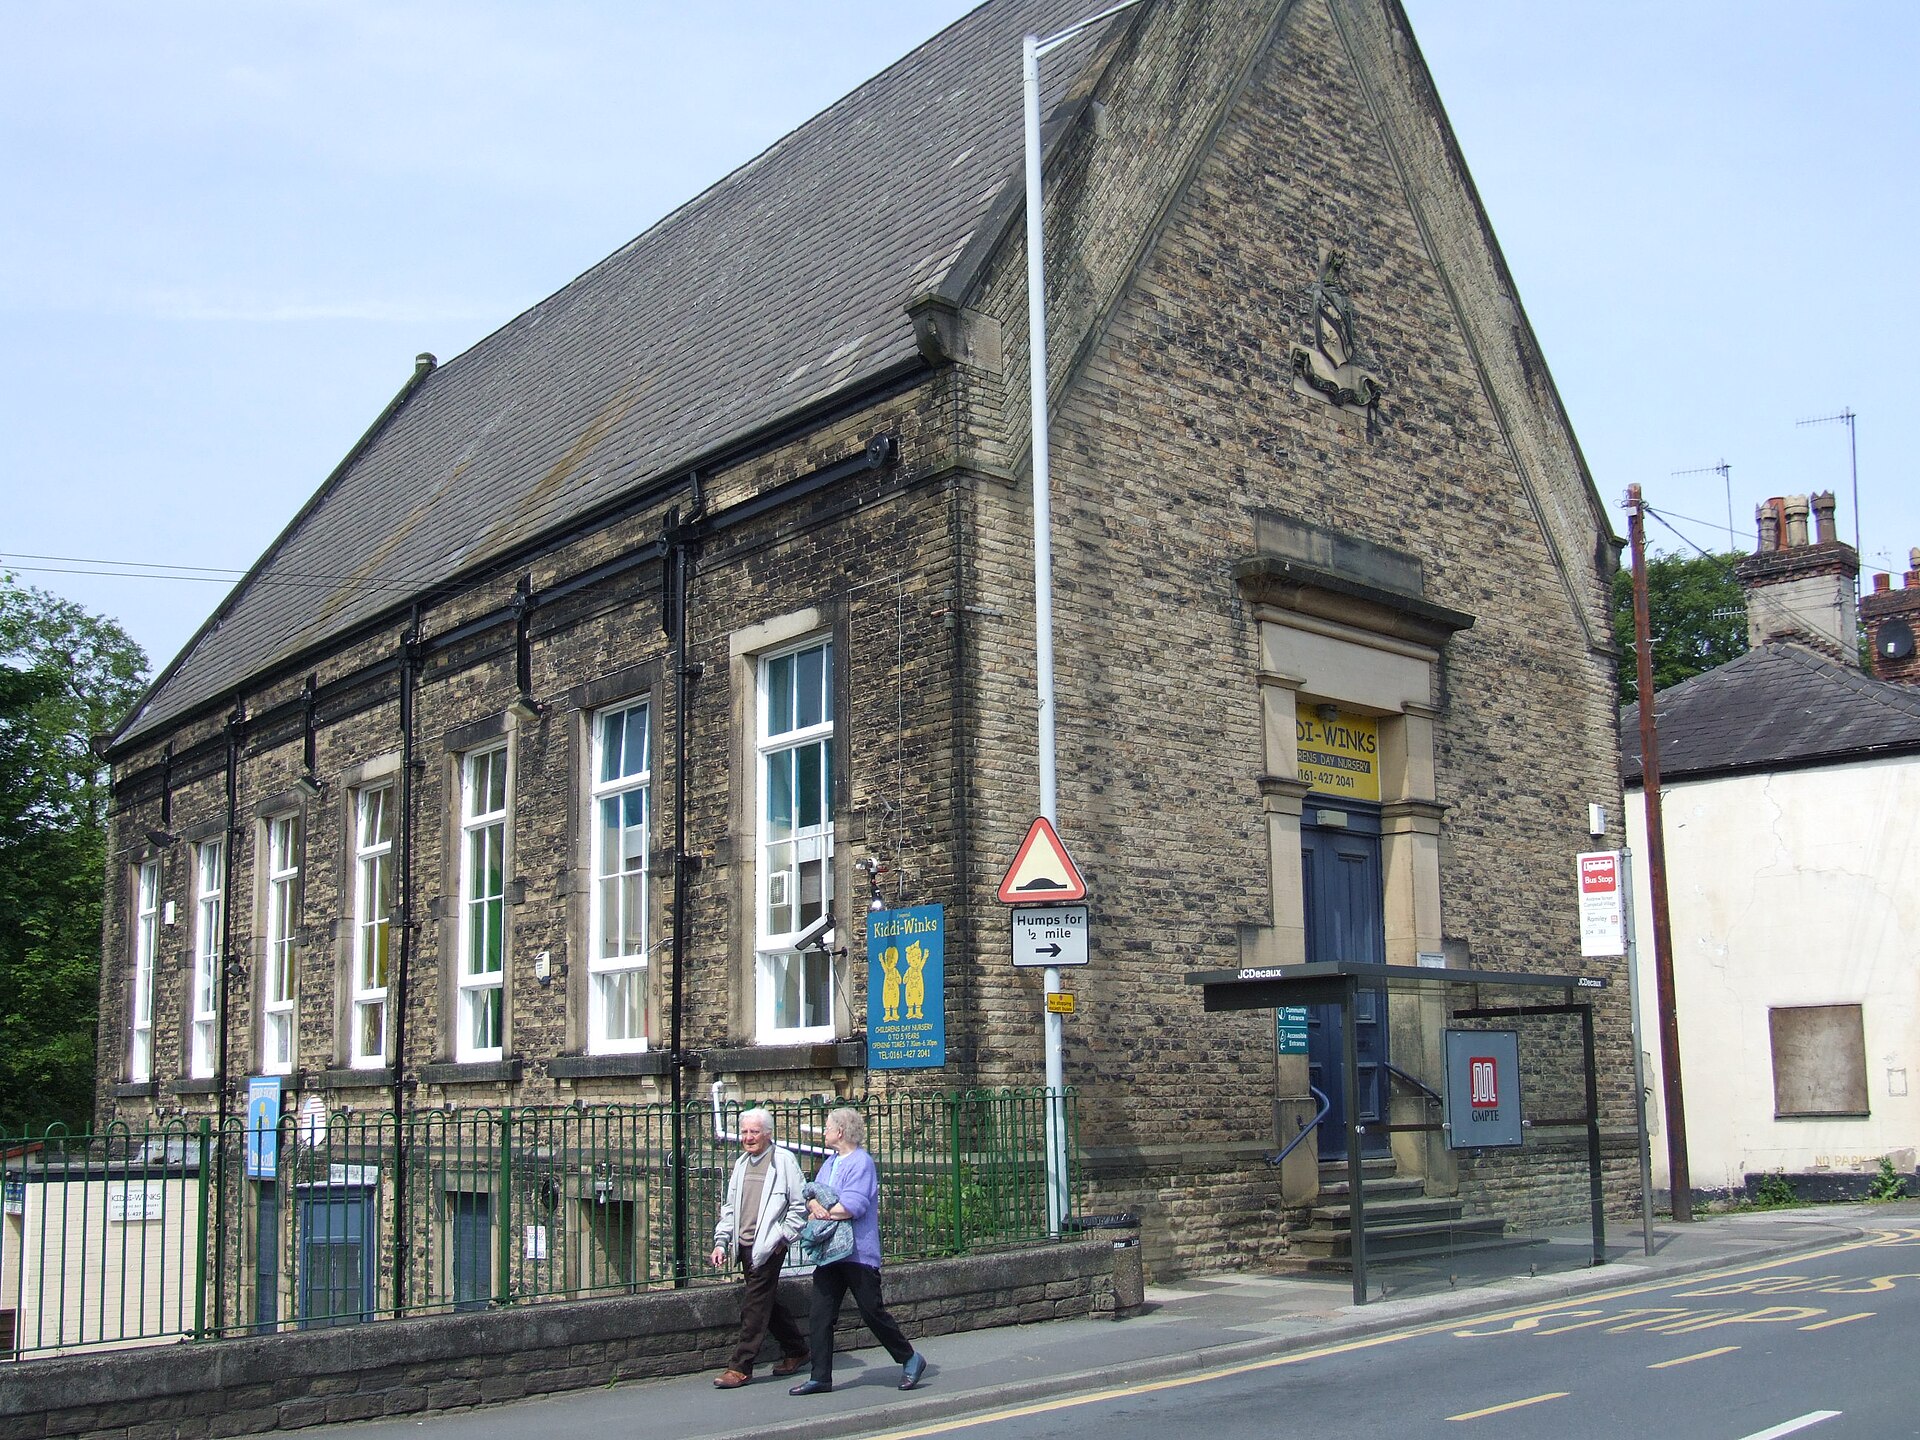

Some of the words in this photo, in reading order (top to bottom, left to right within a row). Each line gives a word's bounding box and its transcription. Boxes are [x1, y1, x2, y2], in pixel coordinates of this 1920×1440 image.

[1320, 754, 1335, 766] DAY
[1338, 757, 1369, 772] NURSERY
[1336, 775, 1354, 788] 2041
[1584, 876, 1597, 884] Bus
[1597, 875, 1613, 884] Stop
[874, 916, 938, 938] Kiddi-Winks
[1017, 915, 1060, 927] Humps
[1065, 914, 1083, 925] for
[1045, 927, 1071, 939] mile
[1237, 968, 1282, 979] JCDecaux
[905, 1032, 920, 1040] YEARS
[1471, 1109, 1500, 1122] GMPTE
